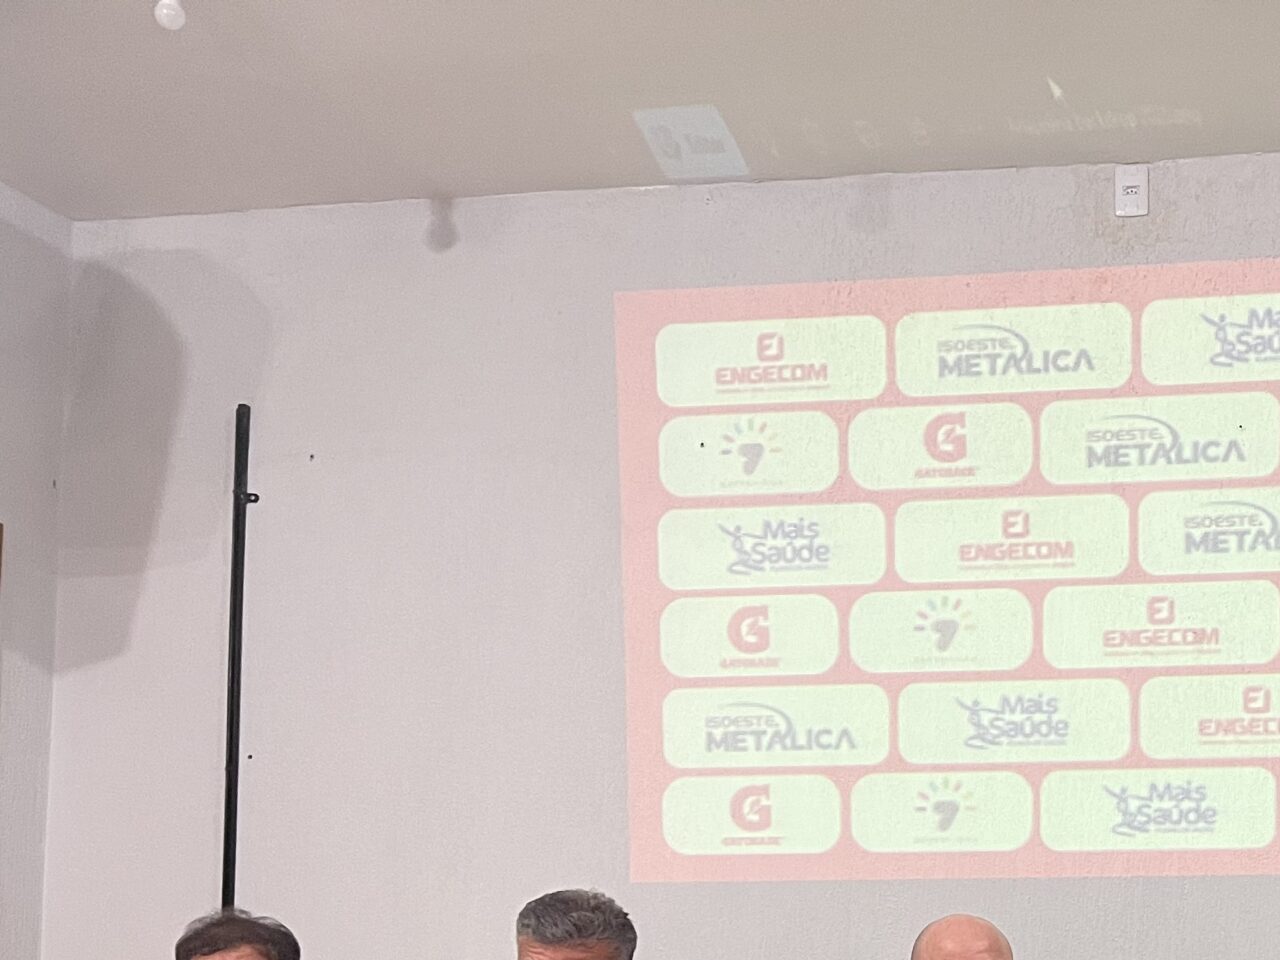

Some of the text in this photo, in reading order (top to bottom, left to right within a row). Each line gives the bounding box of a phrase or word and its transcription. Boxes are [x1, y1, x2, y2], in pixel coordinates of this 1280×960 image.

[715, 363, 829, 386] ENGECOM
[763, 517, 821, 540] Mais
[750, 539, 831, 565] Saúde
[957, 541, 1076, 563] ENGECOM
[1102, 626, 1221, 649] ENGECOM
[1001, 692, 1058, 716] Mais
[989, 714, 1070, 740] Saúde
[1149, 779, 1207, 802] Mais
[1135, 801, 1217, 826] Saúde
